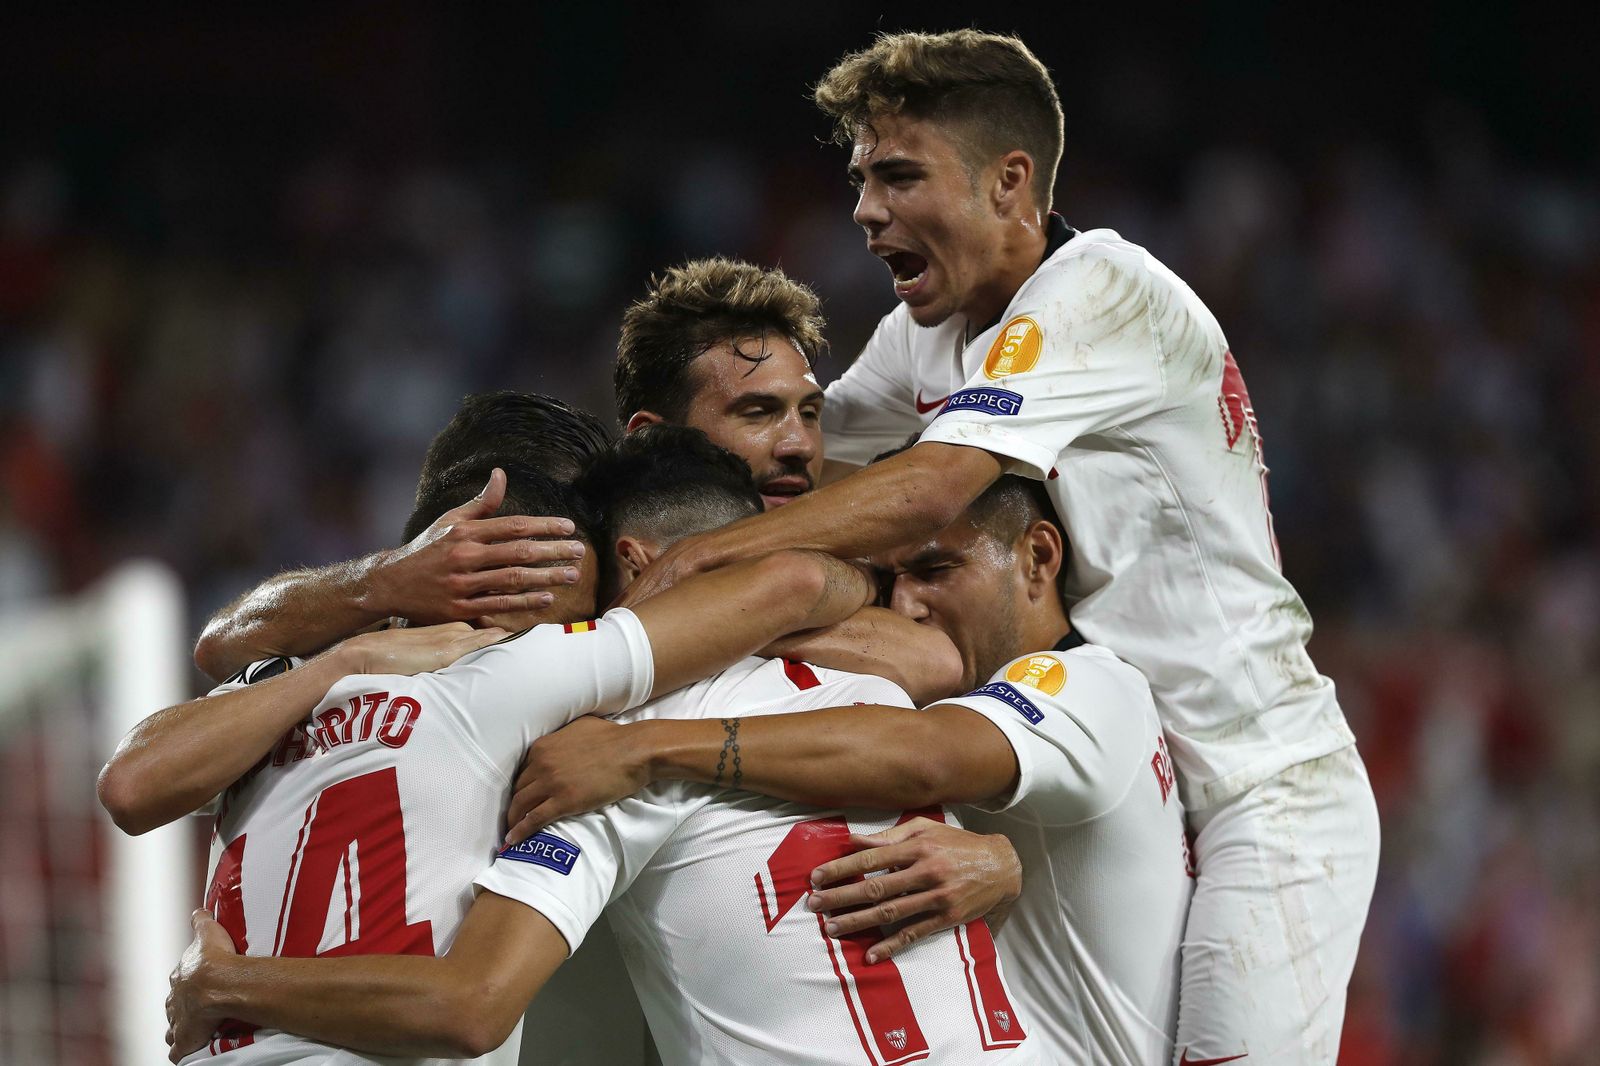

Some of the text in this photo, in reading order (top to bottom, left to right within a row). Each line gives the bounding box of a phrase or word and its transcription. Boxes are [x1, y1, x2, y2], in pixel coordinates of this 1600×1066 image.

[1000, 335, 1022, 357] 5
[949, 394, 1020, 414] RESPECT
[976, 684, 1041, 719] RESPECT
[202, 766, 436, 1056] 14
